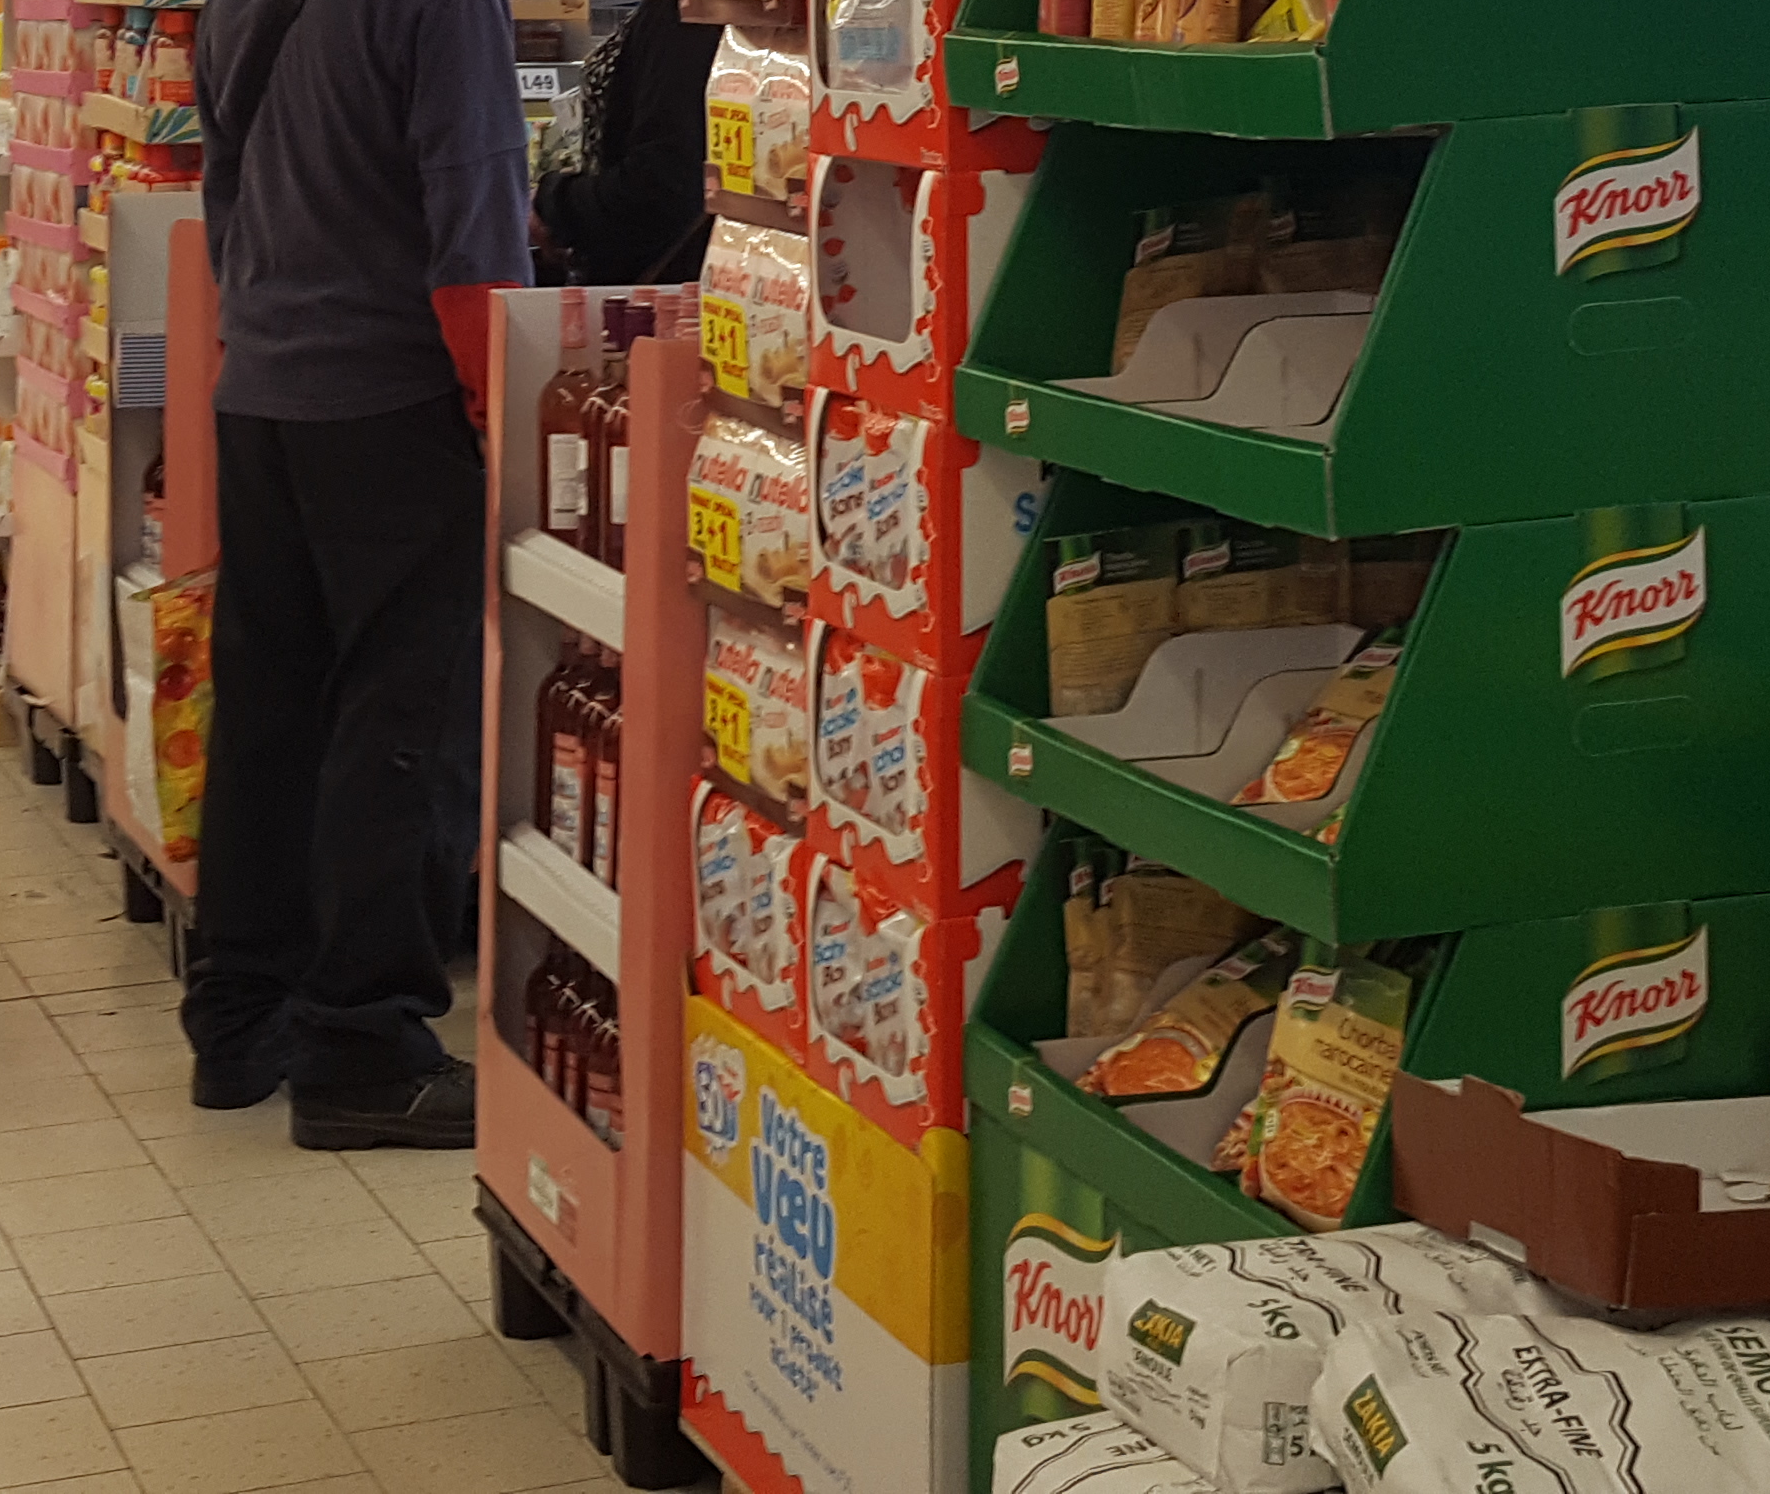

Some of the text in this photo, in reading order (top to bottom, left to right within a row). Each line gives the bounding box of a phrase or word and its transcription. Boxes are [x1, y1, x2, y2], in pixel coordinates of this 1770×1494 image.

[1559, 169, 1694, 240] Knorr
[1565, 568, 1700, 641] Knorr
[1566, 968, 1701, 1043] Knorr
[1008, 1257, 1106, 1352] Knor
